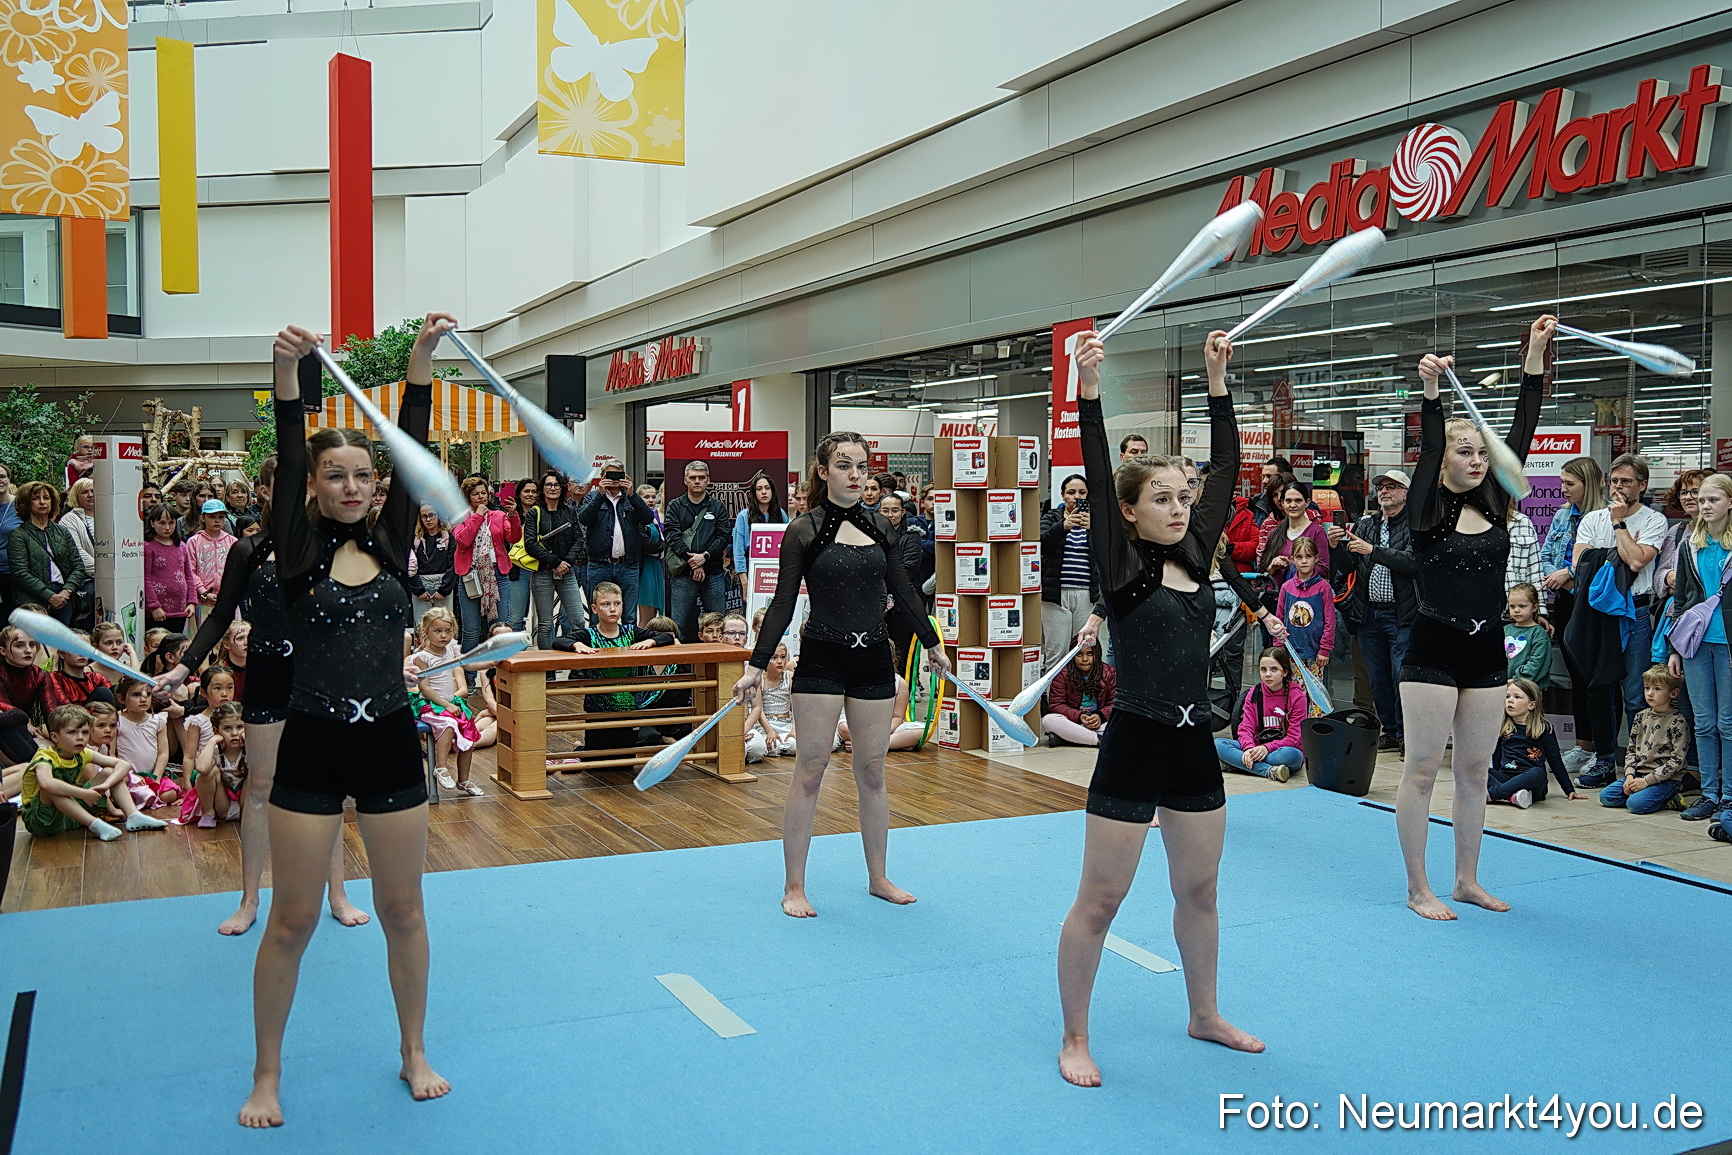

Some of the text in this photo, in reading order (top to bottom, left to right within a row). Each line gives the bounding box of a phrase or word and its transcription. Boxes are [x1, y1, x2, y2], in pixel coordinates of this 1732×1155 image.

[1064, 331, 1081, 402] 1
[1537, 438, 1575, 451] Markt
[756, 536, 772, 554] T
